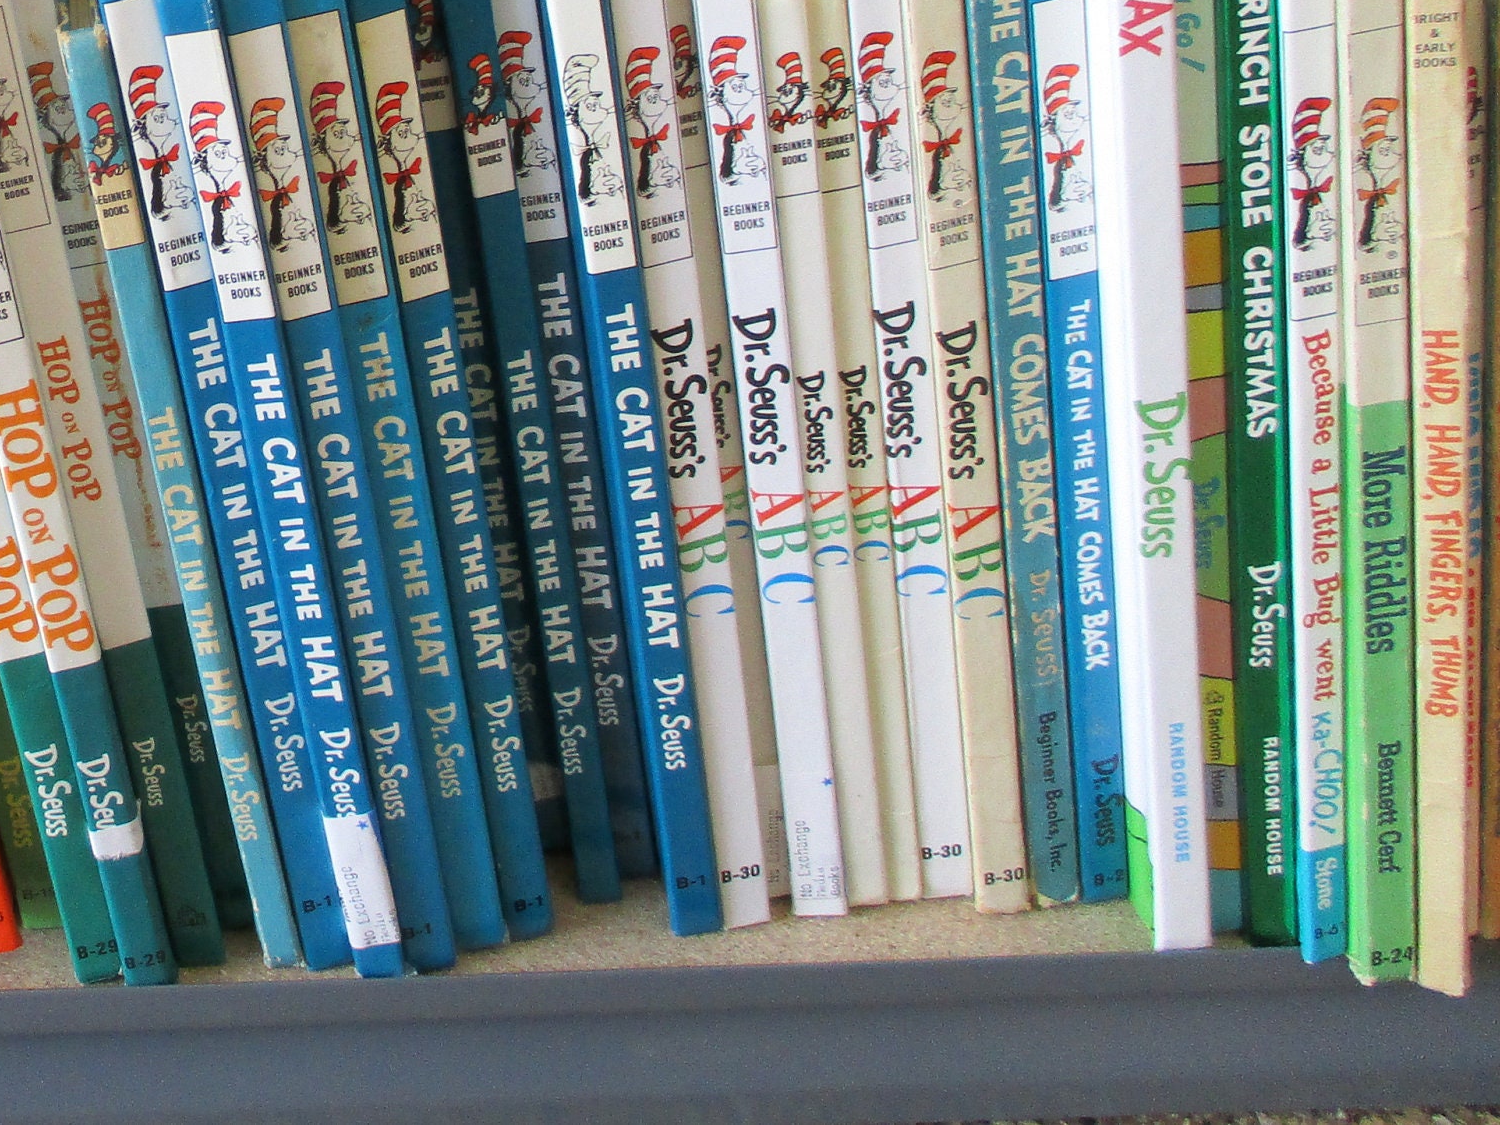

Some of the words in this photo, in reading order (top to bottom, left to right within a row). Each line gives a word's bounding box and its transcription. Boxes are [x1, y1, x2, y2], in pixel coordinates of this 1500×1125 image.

[1413, 12, 1460, 25] BRIGHT
[1430, 29, 1438, 38] &
[1413, 56, 1457, 68] BOOKS
[1414, 42, 1455, 54] EARLY
[1238, 124, 1272, 227] STOLE
[218, 270, 267, 286] BEGINNER
[231, 286, 262, 300] BOOKS
[605, 303, 642, 373] THE
[732, 307, 777, 362] Dr.
[1065, 298, 1093, 345] THE
[1243, 246, 1281, 439] CHRISTMAS
[247, 354, 286, 422] THE
[1065, 349, 1094, 400] CAT
[1302, 329, 1333, 446] Because
[1421, 330, 1459, 409] HAND,
[615, 386, 655, 452] CAT
[747, 363, 790, 466] Seuss's
[1071, 396, 1093, 422] IN
[1134, 391, 1189, 454] Dr.
[262, 437, 306, 505] CAT
[1071, 429, 1097, 471] THE
[1311, 458, 1332, 475] a
[1423, 424, 1462, 501] HAND,
[627, 466, 658, 501] IN
[1073, 474, 1100, 522] HAT
[1140, 456, 1194, 559] Seuss
[1362, 445, 1406, 529] More
[279, 517, 311, 552] IN
[634, 511, 664, 570] THE
[1308, 483, 1339, 565] Little
[289, 564, 322, 622] THE
[1077, 531, 1105, 606] COMES
[1247, 560, 1281, 603] Dr.
[1363, 535, 1409, 656] Riddles
[1423, 509, 1464, 624] FINGERS,
[641, 582, 679, 649] HAT
[1302, 572, 1341, 629] Bug
[1081, 610, 1111, 671] BACK
[1248, 603, 1287, 668] Seuss
[301, 635, 343, 702] HAT
[652, 674, 685, 710] Dr.
[1315, 639, 1336, 702] went
[1425, 635, 1462, 718] THUMB
[24, 743, 58, 785] Dr.
[319, 728, 353, 763] Dr.
[658, 713, 691, 771] Seuss
[329, 767, 360, 818] Seuss
[1262, 736, 1280, 813] RANDOM
[1377, 739, 1401, 827] Bennett
[37, 780, 72, 838] Seuss
[921, 843, 963, 860] B-30
[1263, 816, 1284, 876] HOUSE
[1378, 830, 1402, 874] Cerf
[1314, 857, 1338, 911] Stone
[1370, 947, 1415, 967] B-24
